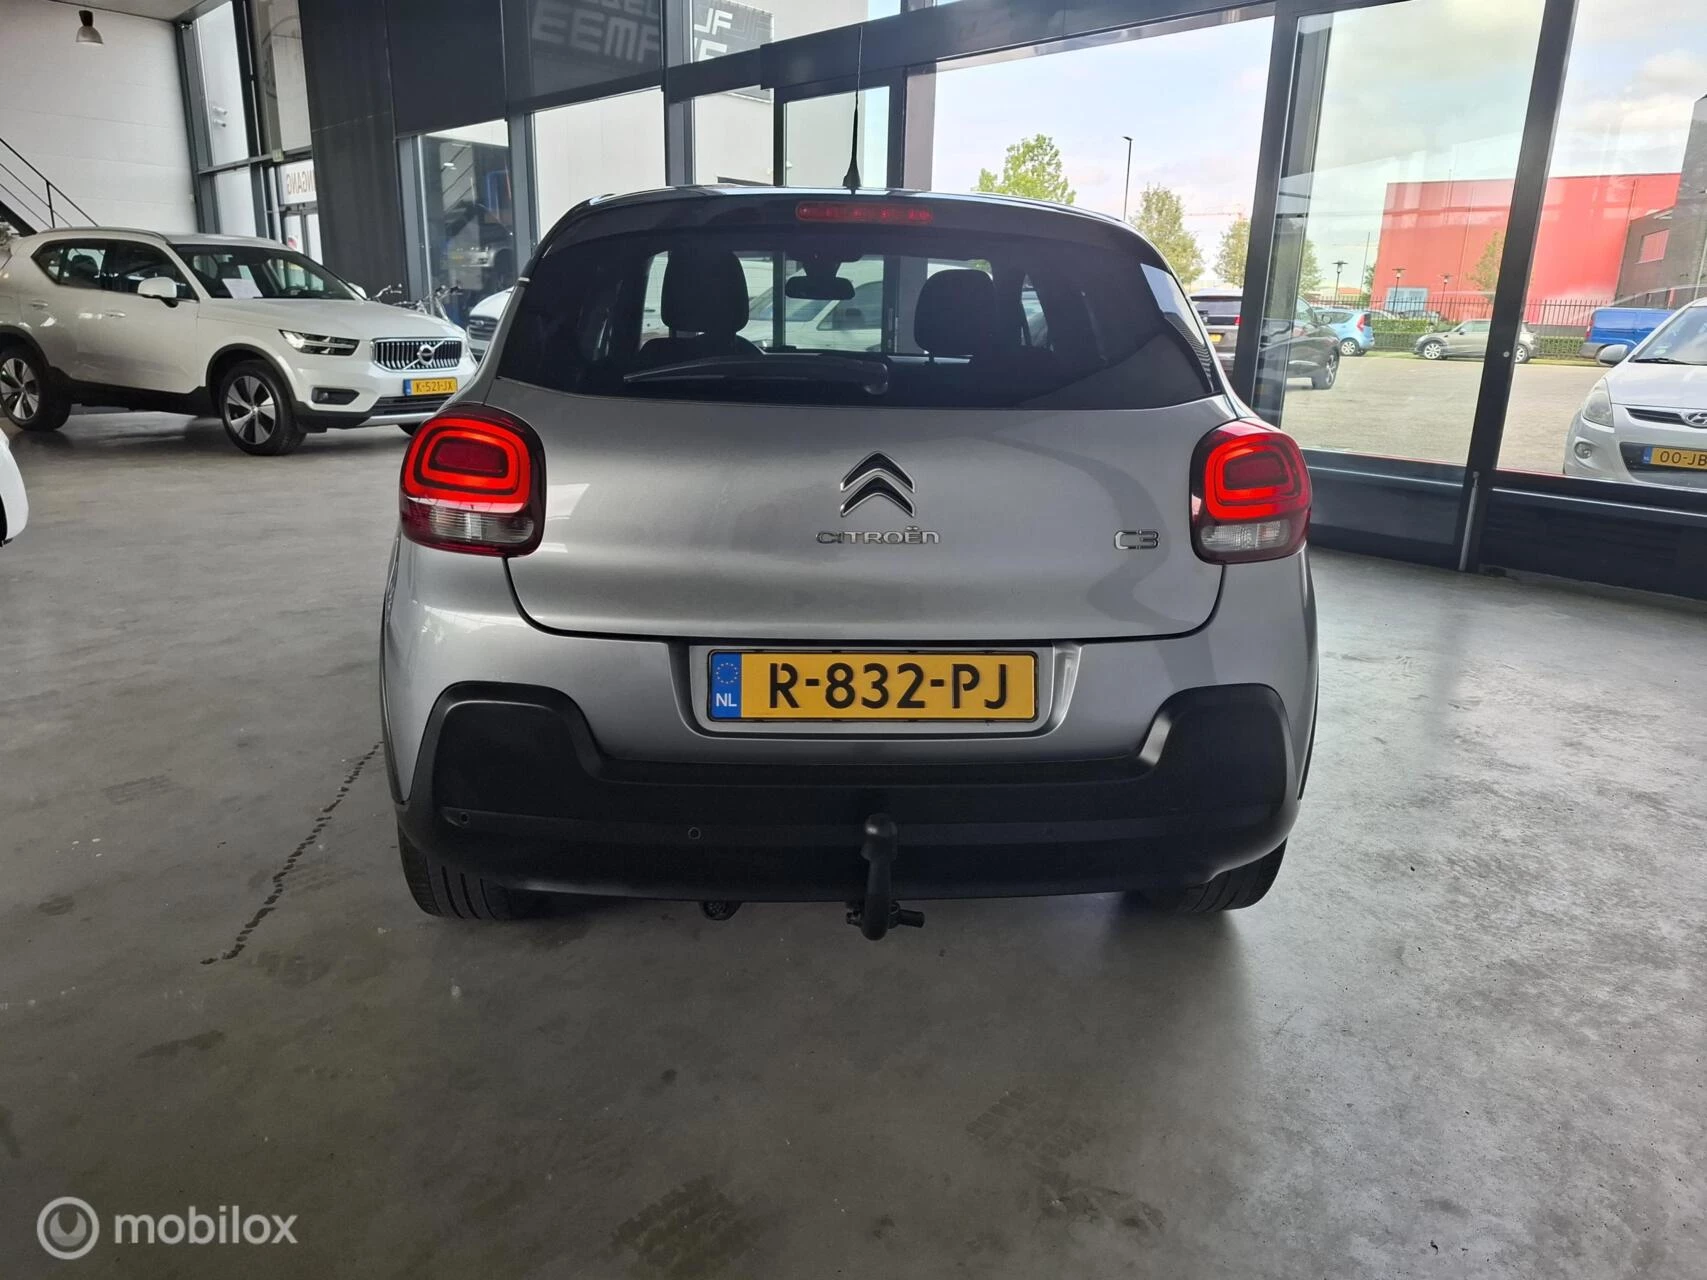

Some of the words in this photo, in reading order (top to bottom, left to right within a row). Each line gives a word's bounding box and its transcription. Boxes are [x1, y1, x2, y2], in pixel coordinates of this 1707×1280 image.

[415, 380, 454, 393] K-521-JX
[1113, 528, 1161, 551] C3
[715, 692, 738, 708] NL
[769, 662, 1008, 710] R-832-PJ
